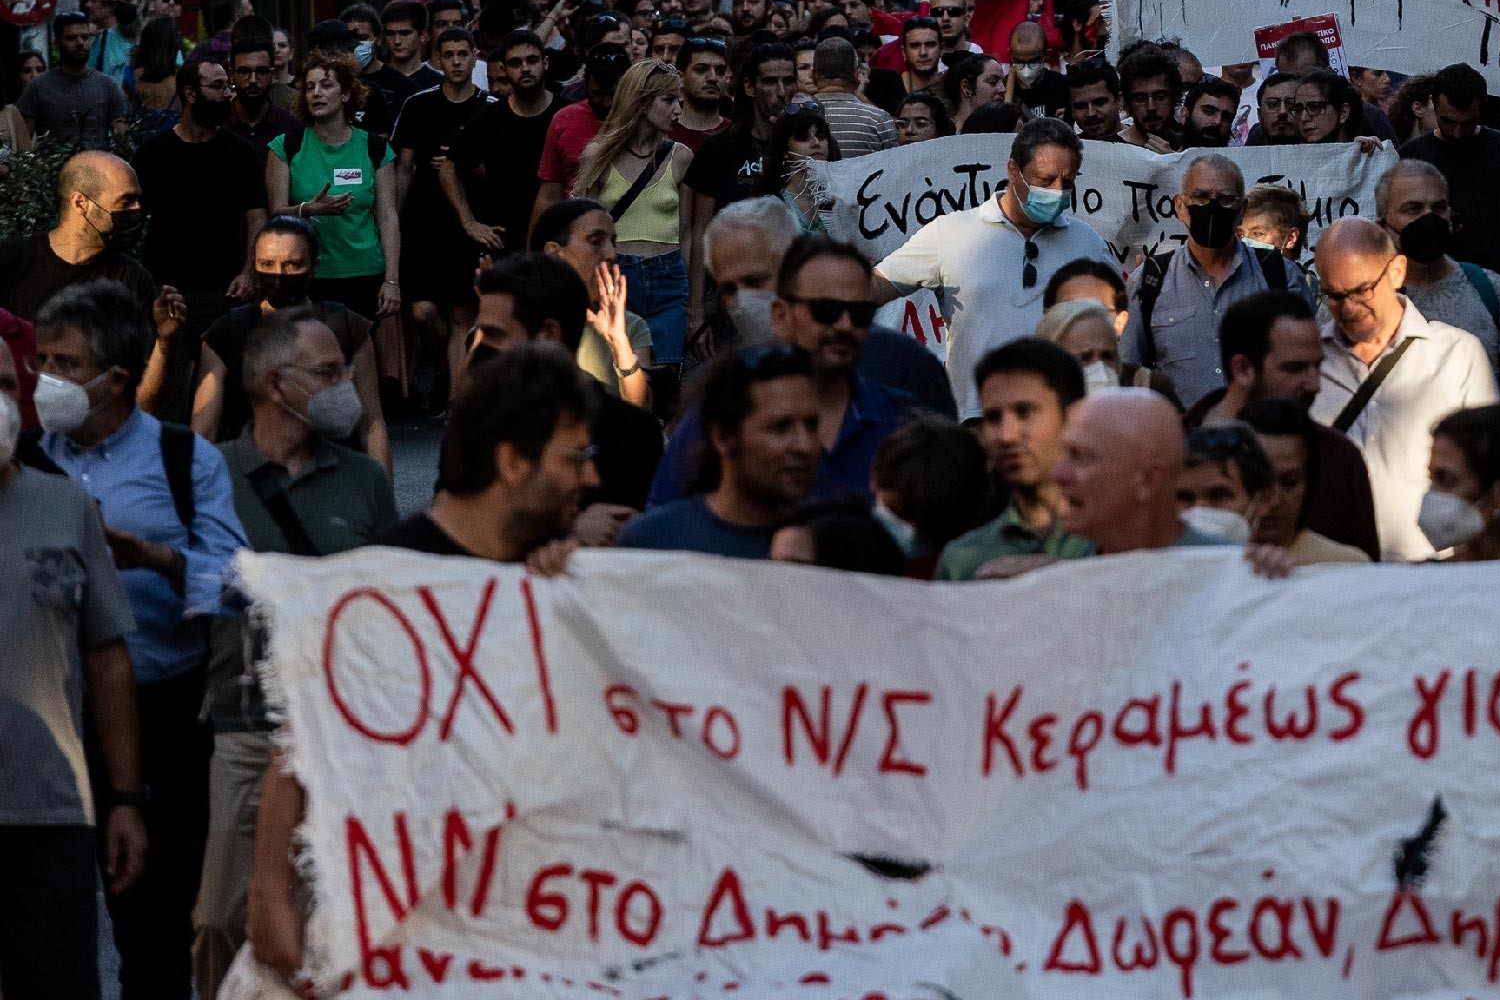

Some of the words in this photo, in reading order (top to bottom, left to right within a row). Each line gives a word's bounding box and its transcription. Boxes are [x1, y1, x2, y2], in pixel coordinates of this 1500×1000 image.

[323, 578, 558, 746] ΟΧΙ
[783, 682, 932, 777] Ν/Σ
[983, 660, 1366, 791] Κεραμέως
